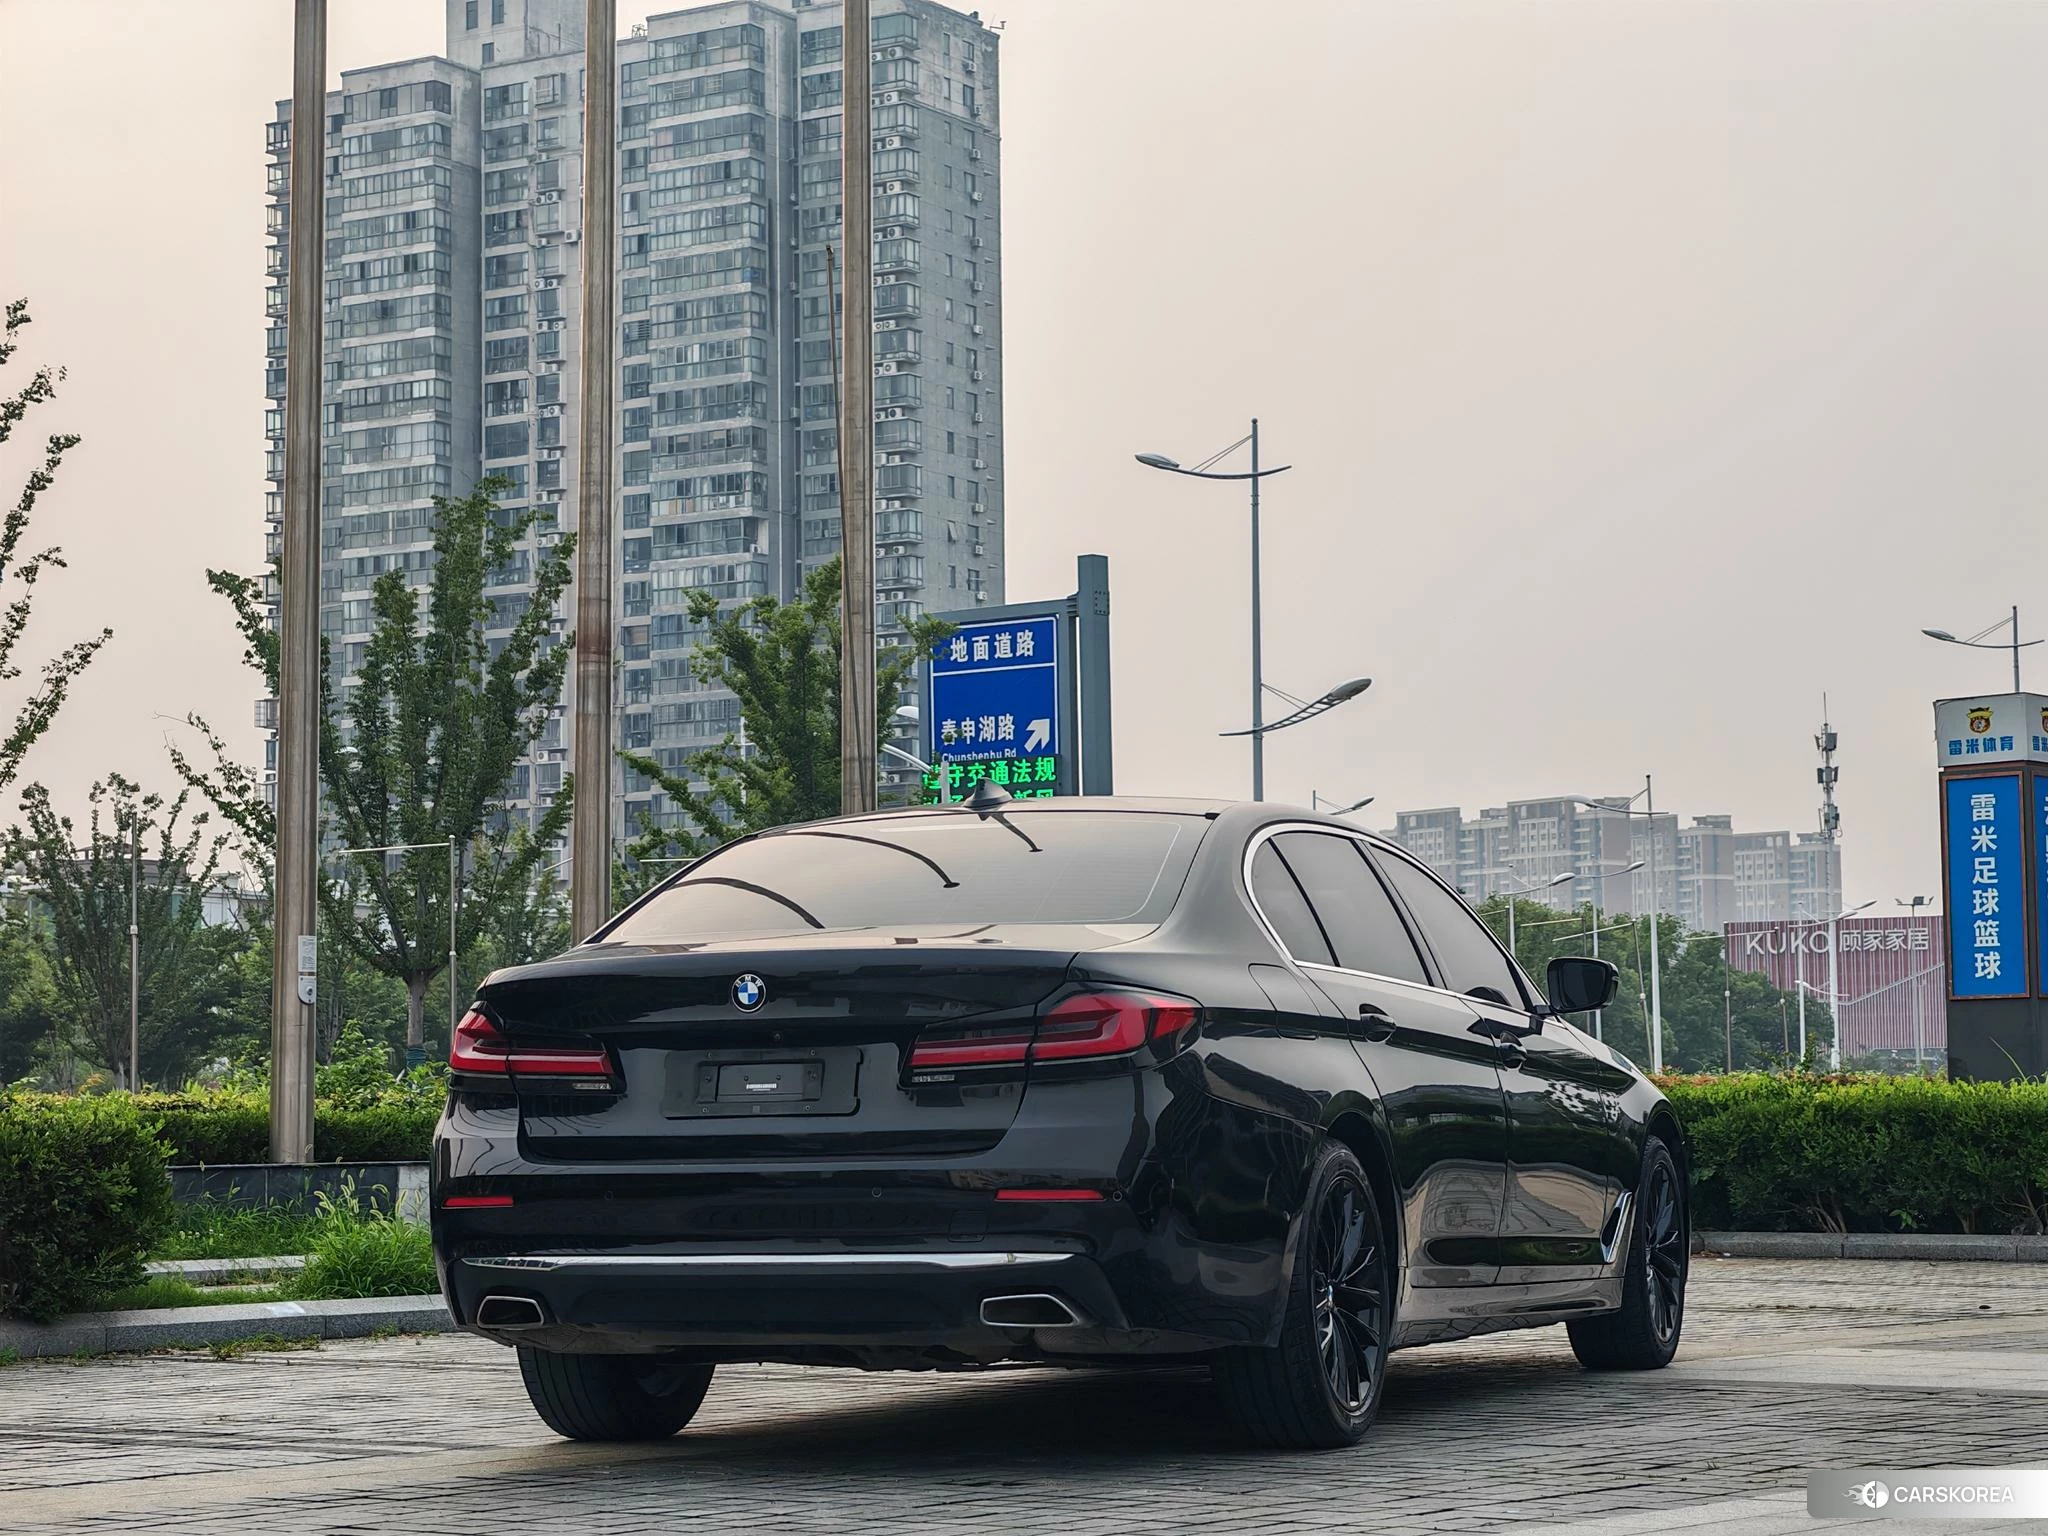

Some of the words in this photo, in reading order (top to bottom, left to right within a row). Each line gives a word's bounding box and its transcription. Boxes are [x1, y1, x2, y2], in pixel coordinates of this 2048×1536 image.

[950, 629, 1035, 663] 地面道路
[941, 713, 1015, 746] 春申湖路
[941, 750, 1002, 762] Chunshenhu
[1004, 747, 1017, 758] Rd
[1948, 735, 2014, 756] 雷米体育
[1970, 793, 2002, 980] 雷米足球篮球
[1839, 927, 1930, 953] 顾家家居
